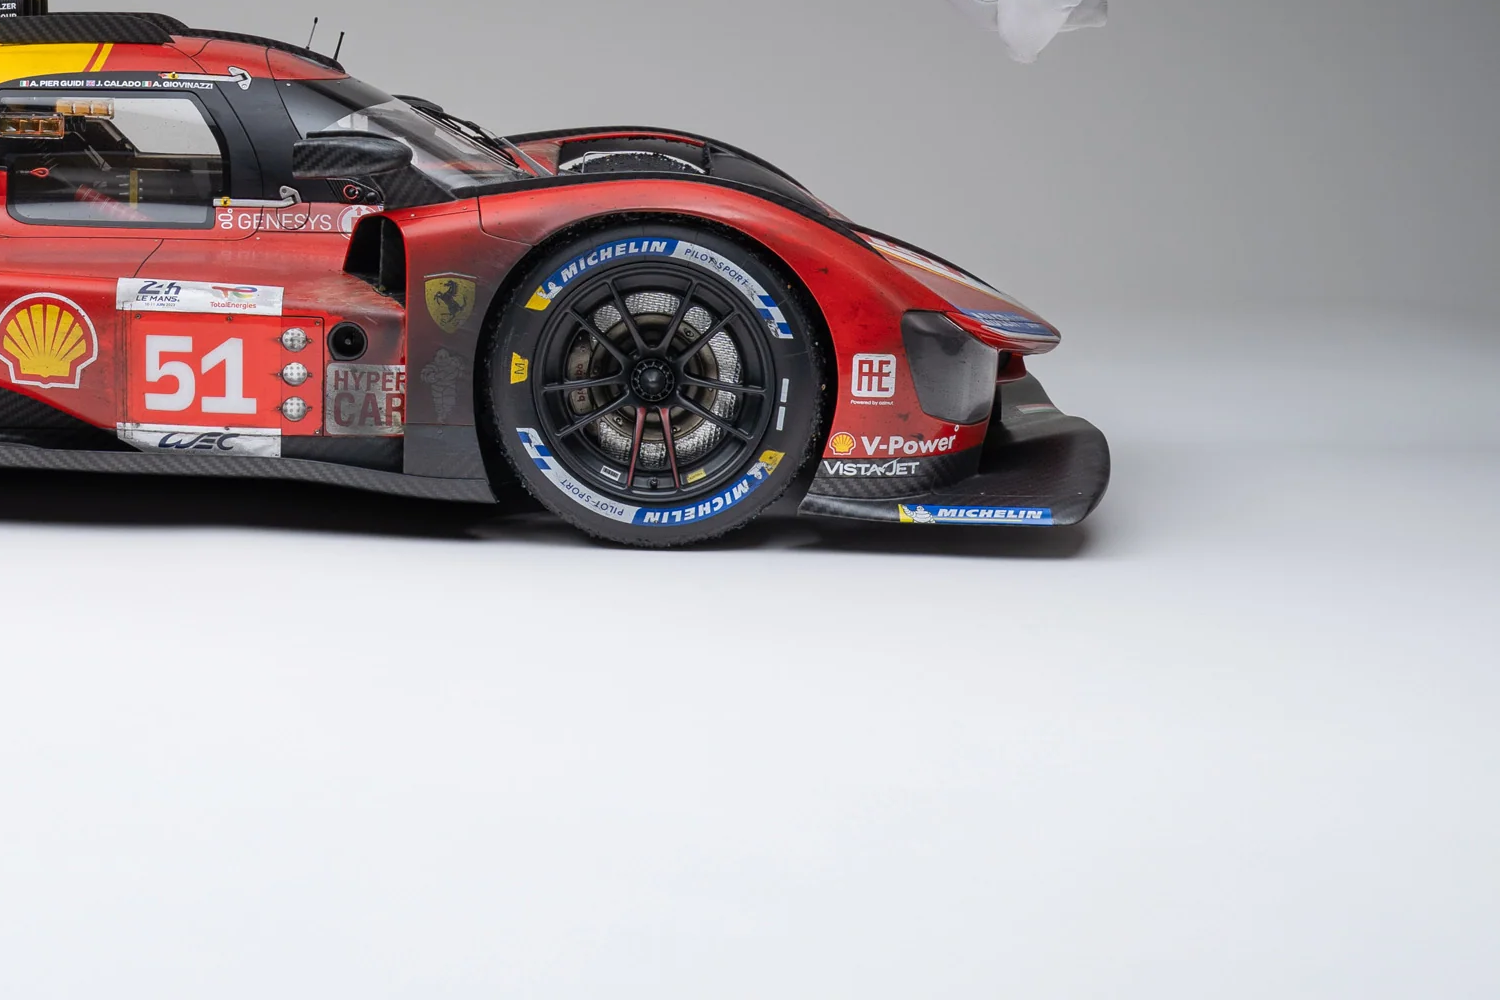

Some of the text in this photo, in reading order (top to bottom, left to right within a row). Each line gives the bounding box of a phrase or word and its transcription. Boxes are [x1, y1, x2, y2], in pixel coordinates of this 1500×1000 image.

[162, 81, 214, 90] GIOVINAZZI
[237, 213, 332, 231] GENESYS
[560, 240, 668, 283] MICHELIN
[716, 260, 749, 287] SPORT
[209, 301, 257, 310] TotalEnergies
[144, 334, 257, 415] 51
[334, 392, 406, 427] CAR
[158, 431, 241, 451] WEC
[860, 434, 957, 456] V-Power
[643, 478, 750, 524] MICHELIN
[937, 508, 1043, 519] MICHELIN
